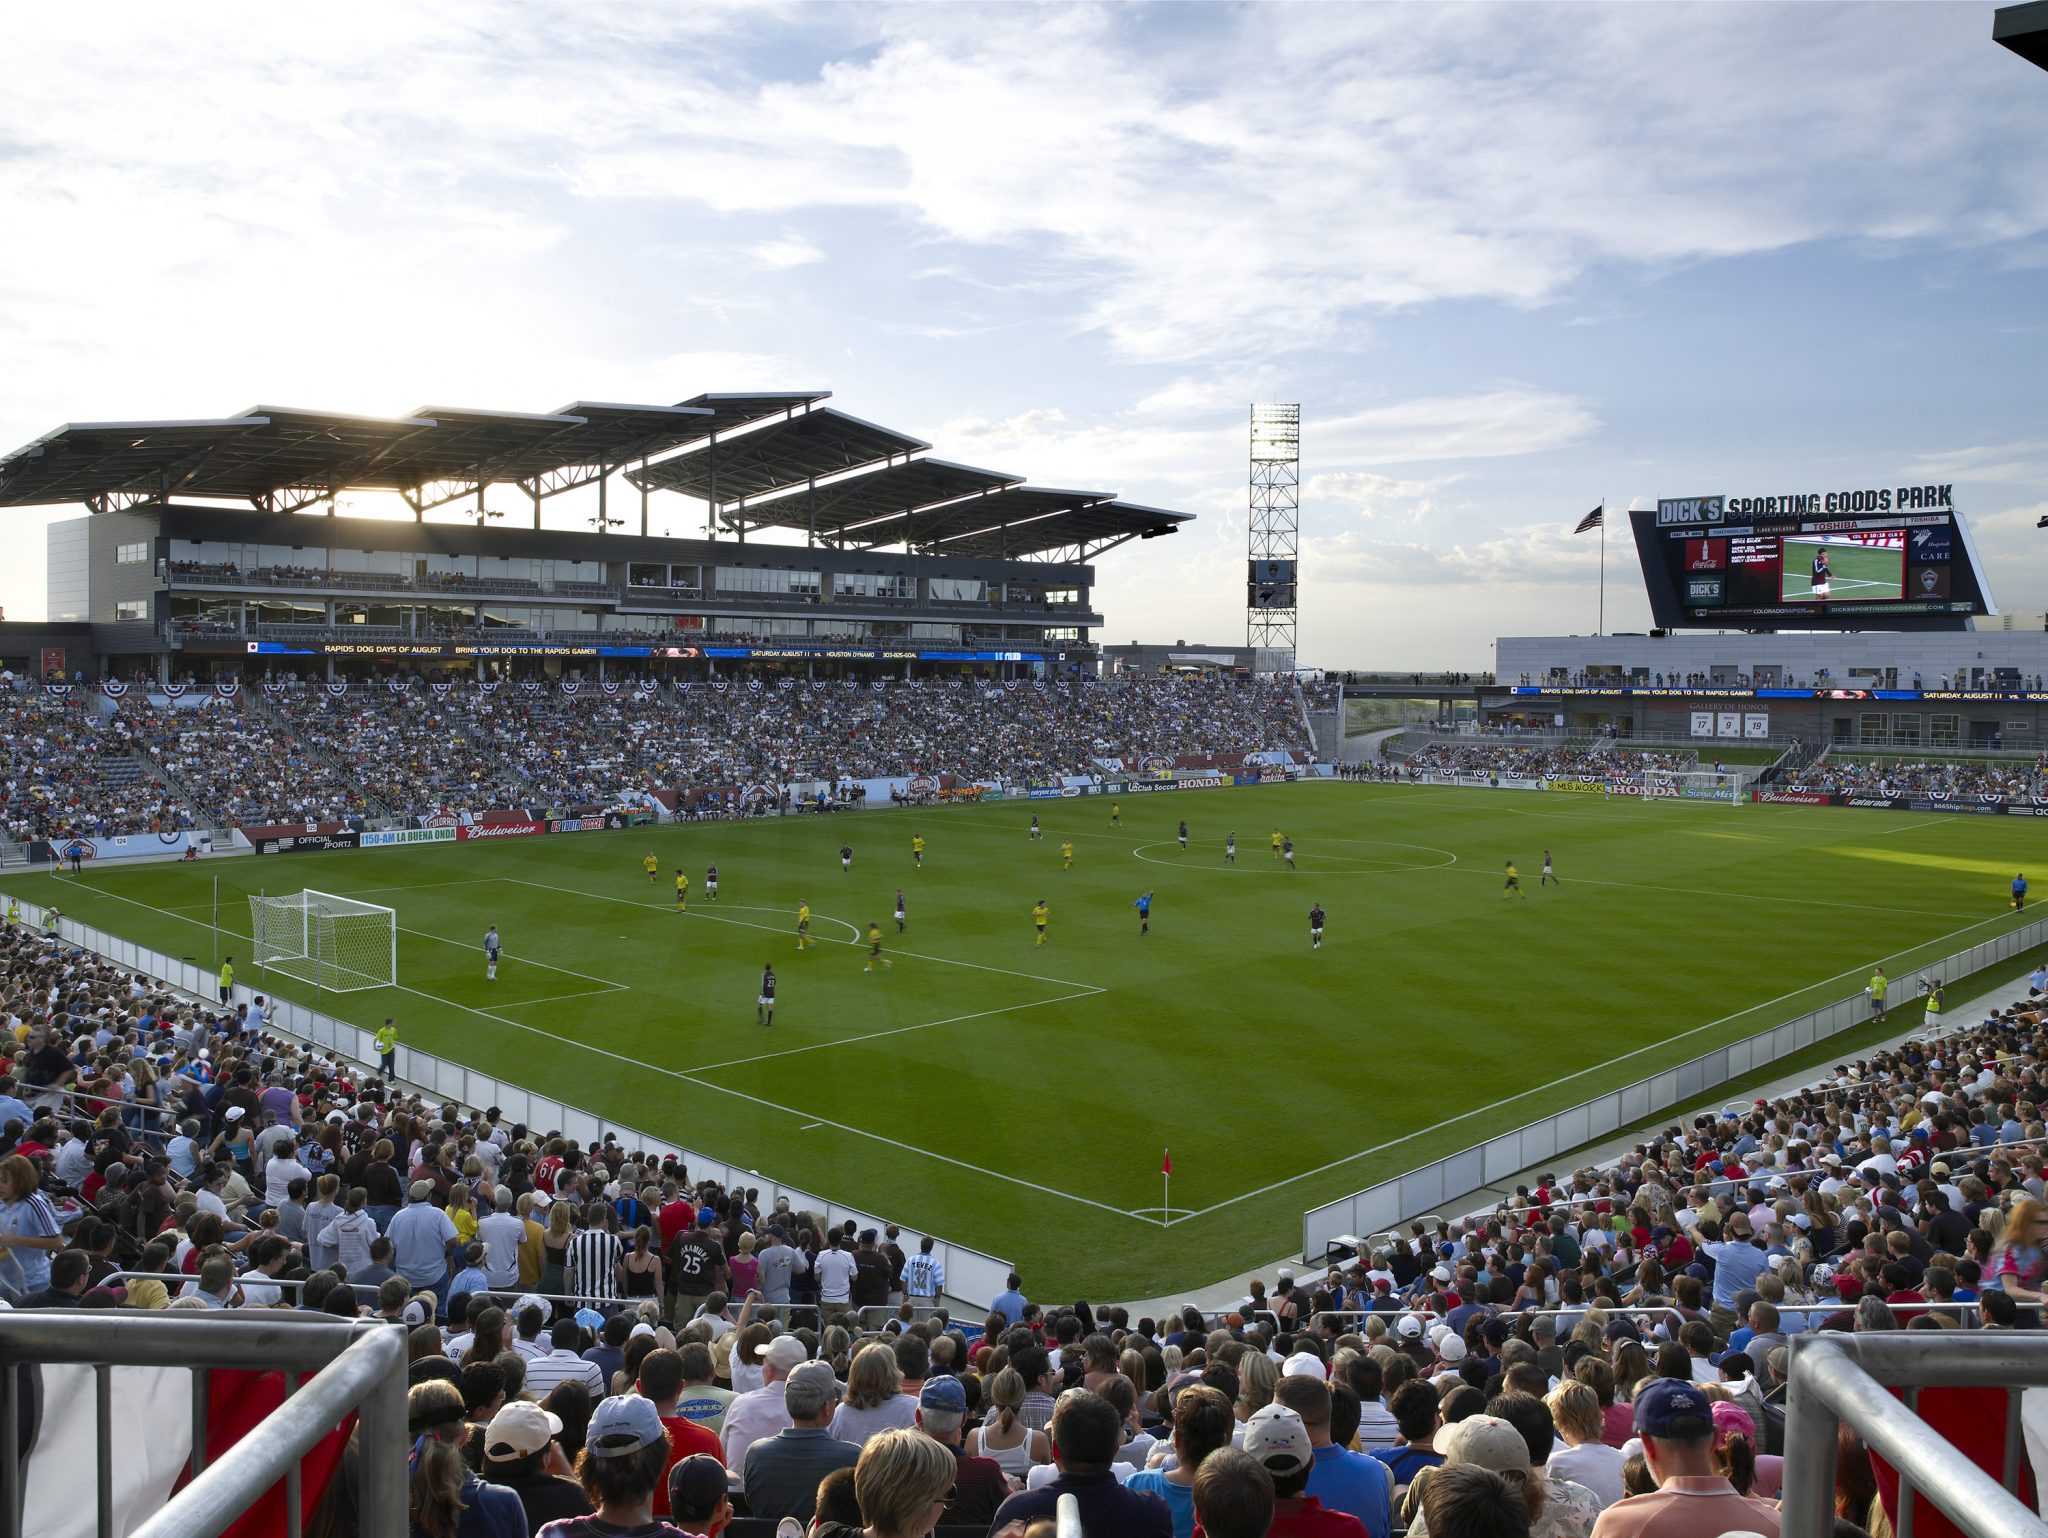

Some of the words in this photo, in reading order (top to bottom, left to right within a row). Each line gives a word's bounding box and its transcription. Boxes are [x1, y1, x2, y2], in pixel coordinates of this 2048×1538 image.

[1727, 493, 1821, 520] SPORTING
[1824, 488, 1892, 513] GOODS
[1896, 483, 1953, 510] PARK
[1660, 500, 1720, 523] DICK'S
[1910, 516, 1940, 524] TOSHIBA
[1812, 520, 1858, 531] TOSHIBA
[1920, 552, 1951, 560] CARE
[1690, 583, 1720, 595] DICK'S
[324, 645, 355, 653] RAPIDS
[356, 645, 374, 653] DOG
[411, 646, 442, 654] AUGUST
[455, 646, 478, 654] BRING
[529, 647, 543, 655] THE
[852, 651, 875, 659] DYNAMO
[1689, 702, 1724, 711] GALLERY
[1725, 703, 1737, 711] OF
[1738, 703, 1770, 712] HONOR
[1697, 720, 1707, 729] 17
[1725, 721, 1732, 730] 9
[1752, 721, 1762, 730] 19
[1154, 783, 1178, 792] Soccer
[1178, 777, 1222, 790] HONDA
[1557, 782, 1574, 791] MLS
[1612, 784, 1680, 797] HONDA
[1686, 788, 1712, 798] Sierra
[1760, 791, 1820, 804] Budweiser
[1848, 798, 1892, 808] Gatorade
[1933, 802, 1992, 812] 866ShipBags.com
[429, 817, 458, 828] COLORADO
[550, 820, 561, 833] US
[561, 819, 581, 832] YOUTH
[581, 817, 605, 831] SOCCER
[465, 824, 536, 839] Budweiser
[116, 837, 128, 845] 124
[298, 835, 332, 845] OFFICIAL
[360, 834, 396, 846] 1150-AM
[396, 833, 406, 844] LA
[407, 831, 434, 843] BUENA
[434, 828, 456, 840] ONDA
[540, 1162, 556, 1181] 61
[682, 1254, 702, 1275] 25
[911, 1261, 933, 1272] TEVEZ
[913, 1268, 928, 1290] 32
